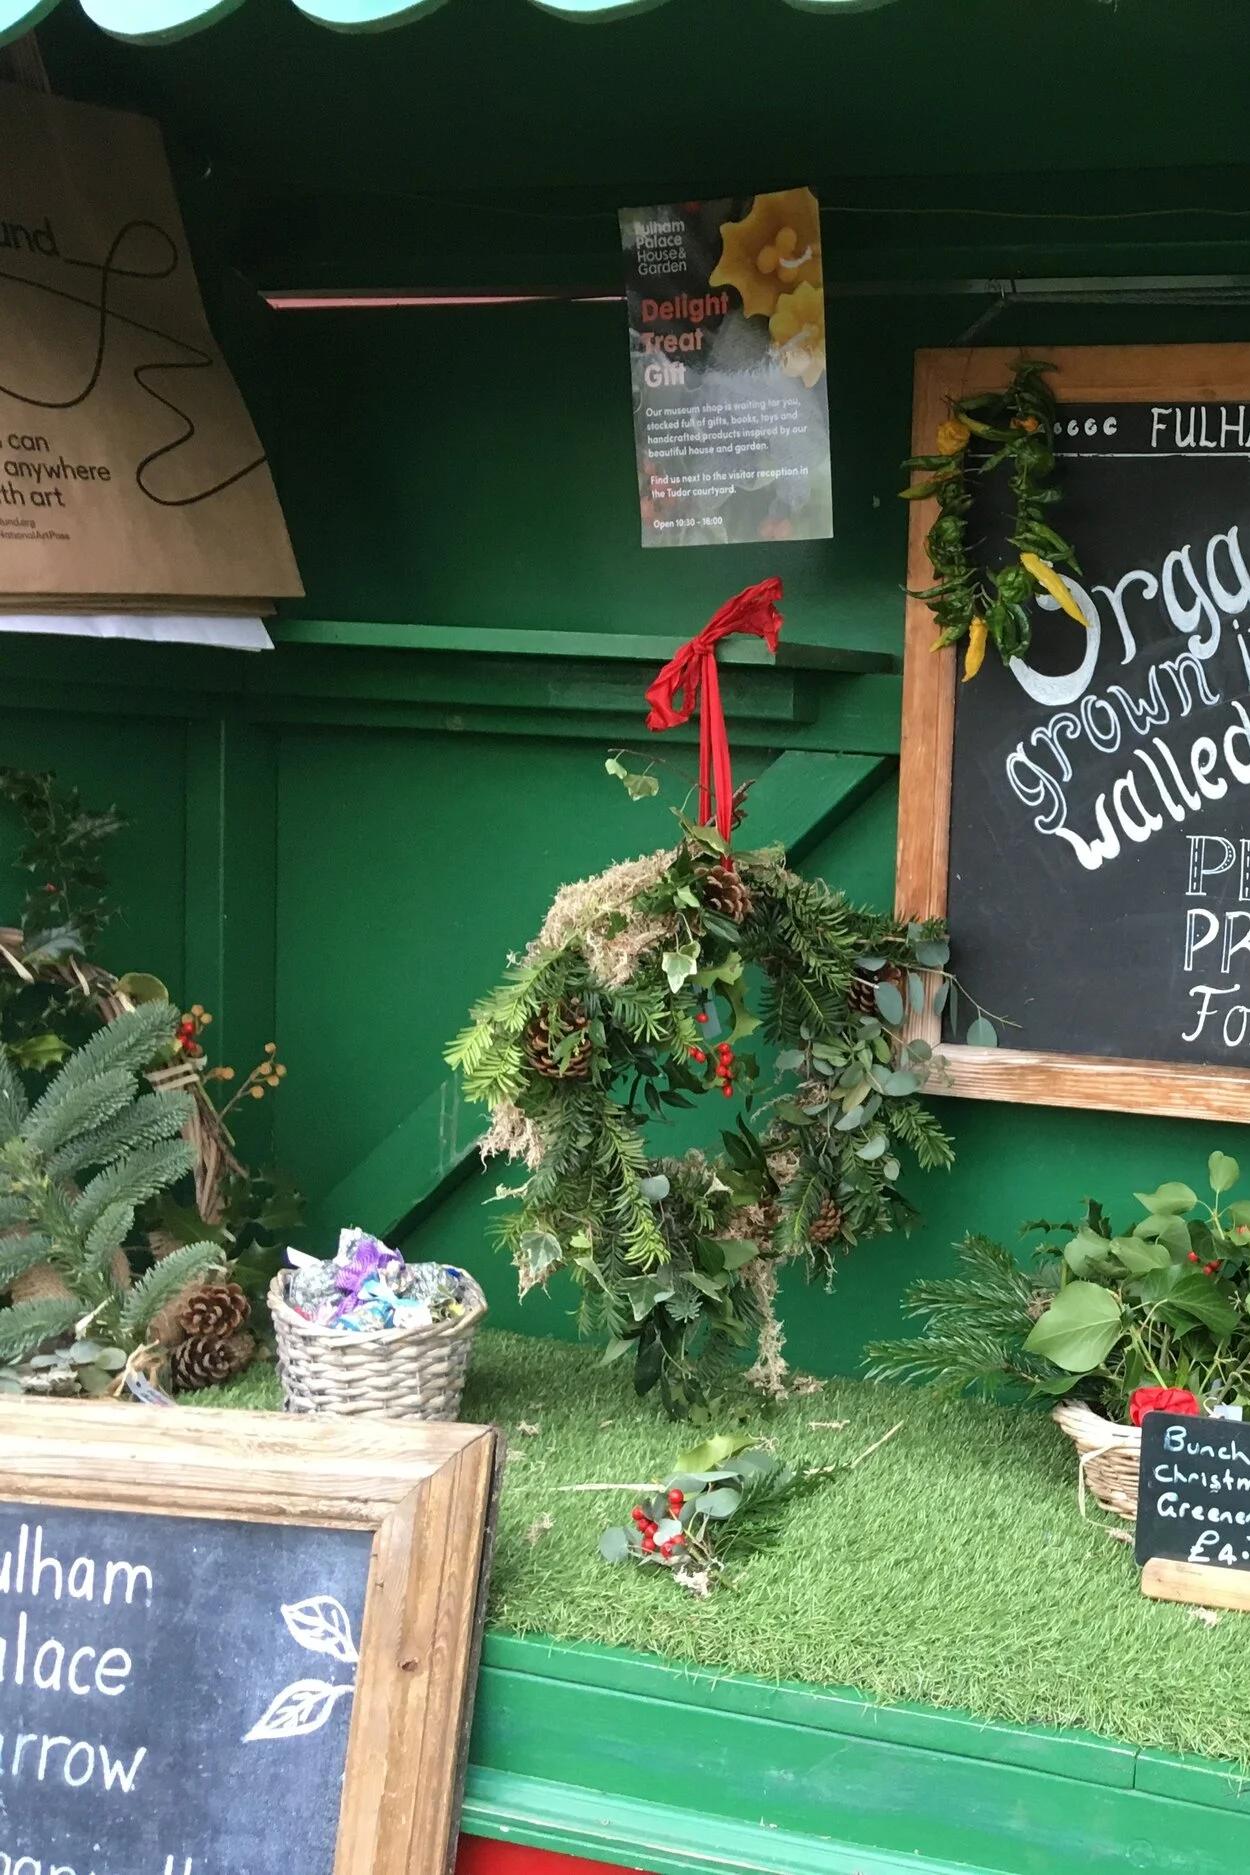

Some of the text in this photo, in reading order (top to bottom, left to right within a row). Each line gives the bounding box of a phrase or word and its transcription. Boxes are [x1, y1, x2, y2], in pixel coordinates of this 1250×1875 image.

[634, 220, 685, 236] Fulham
[636, 234, 683, 250] Palace
[638, 260, 688, 276] Garden
[641, 291, 730, 324] Delight
[641, 327, 704, 354] Treat
[644, 361, 687, 388] Gift
[645, 407, 662, 417] Our
[664, 405, 700, 416] museum
[702, 402, 723, 414] shop
[724, 401, 732, 411] is
[733, 400, 766, 410] waiting
[768, 399, 780, 408] for
[646, 409, 798, 431] stocked full of gifts, books, toys and
[7, 433, 50, 452] can
[647, 424, 808, 444] handcrafted products inspired by our
[648, 441, 769, 458] beautiful house and garden.
[4, 456, 112, 483] anywhere
[650, 465, 809, 485] Find us next to the visitor reception in
[30, 487, 66, 507] art
[651, 484, 737, 499] the Tudor courtyard.
[653, 519, 675, 530] Open
[675, 518, 695, 527] 10:30
[1006, 651, 1220, 835] grown
[0, 1611, 132, 1696] lace
[0, 1732, 147, 1793] rrow
